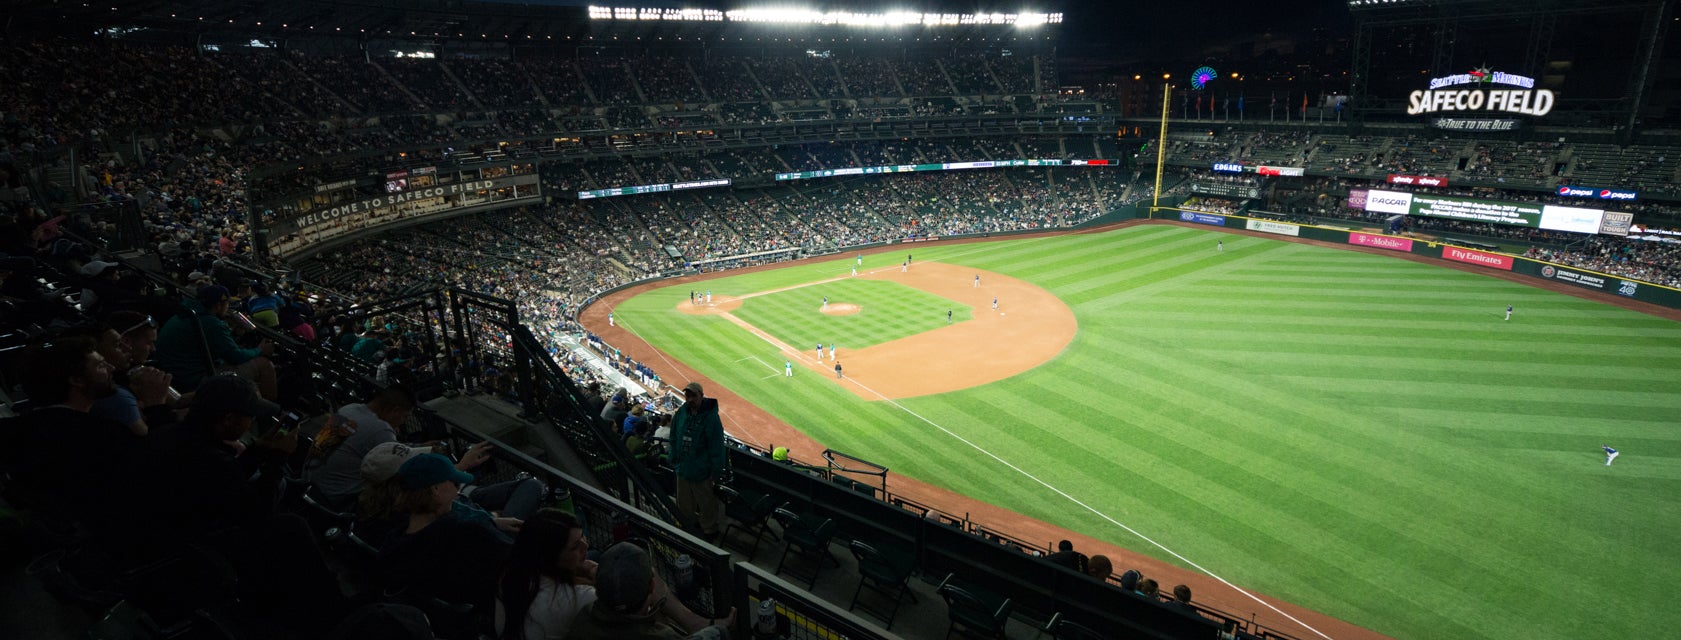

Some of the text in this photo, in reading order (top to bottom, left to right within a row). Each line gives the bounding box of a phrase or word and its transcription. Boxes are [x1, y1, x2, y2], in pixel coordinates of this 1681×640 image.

[1407, 89, 1554, 116] SAFECO FIELD
[1445, 119, 1515, 129] TRUE TO THE BLUE
[1569, 189, 1593, 197] pepsi
[1610, 192, 1635, 200] pepsi
[297, 180, 495, 228] WELCOME TO SAFECO FIELD
[1372, 197, 1407, 206] PACCAR
[1605, 213, 1630, 222] BUILT
[1451, 249, 1502, 265] Fly Emirates
